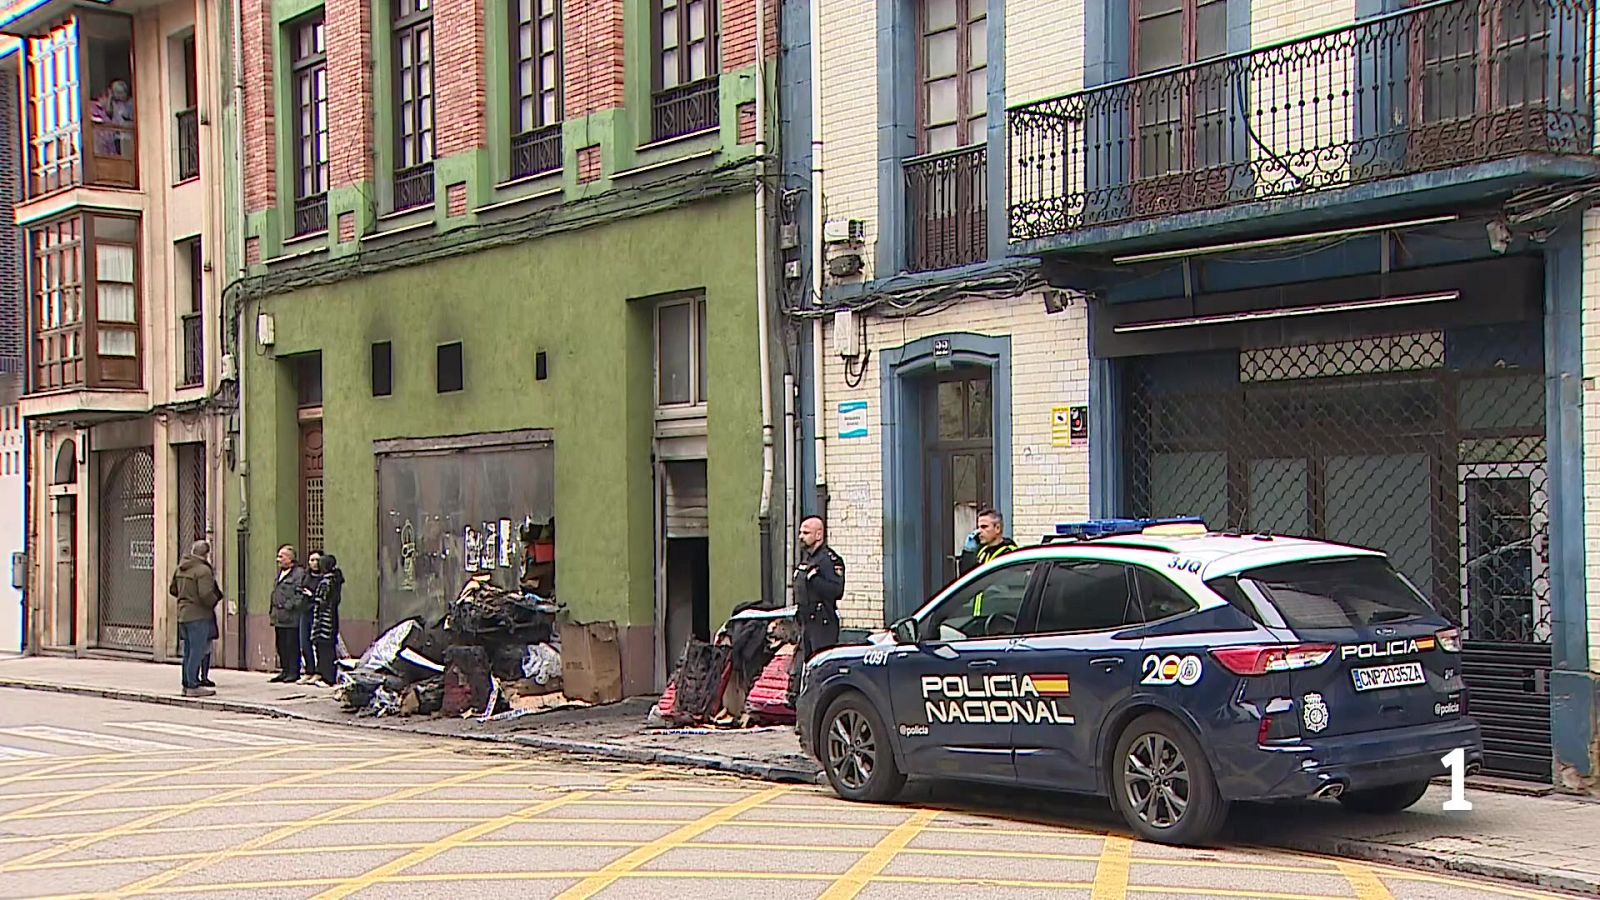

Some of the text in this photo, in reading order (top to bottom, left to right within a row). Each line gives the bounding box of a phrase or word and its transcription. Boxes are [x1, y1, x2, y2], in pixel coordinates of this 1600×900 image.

[1167, 556, 1202, 575] 3JQ
[1359, 665, 1423, 688] CNP2035ZA
[925, 700, 1075, 724] NACIONAL
